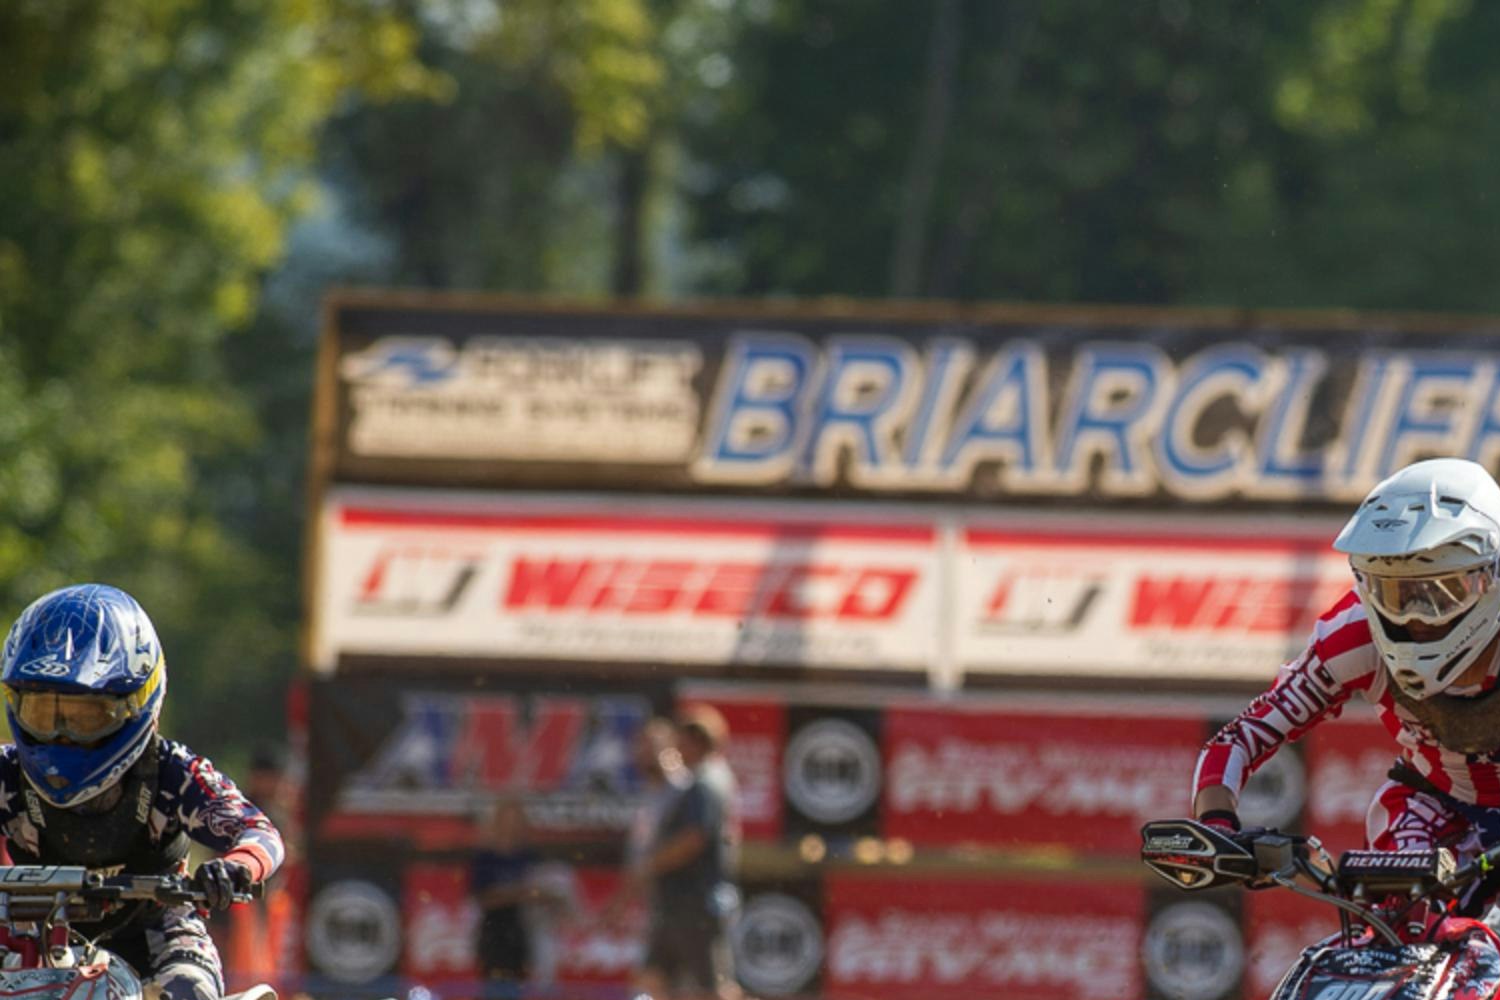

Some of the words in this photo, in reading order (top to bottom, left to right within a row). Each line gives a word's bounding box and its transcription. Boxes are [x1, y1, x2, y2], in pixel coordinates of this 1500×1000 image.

[502, 553, 922, 623] WISECO
[350, 695, 655, 795] AMA
[135, 782, 153, 825] LEATT
[1344, 856, 1432, 868] RENTHAL
